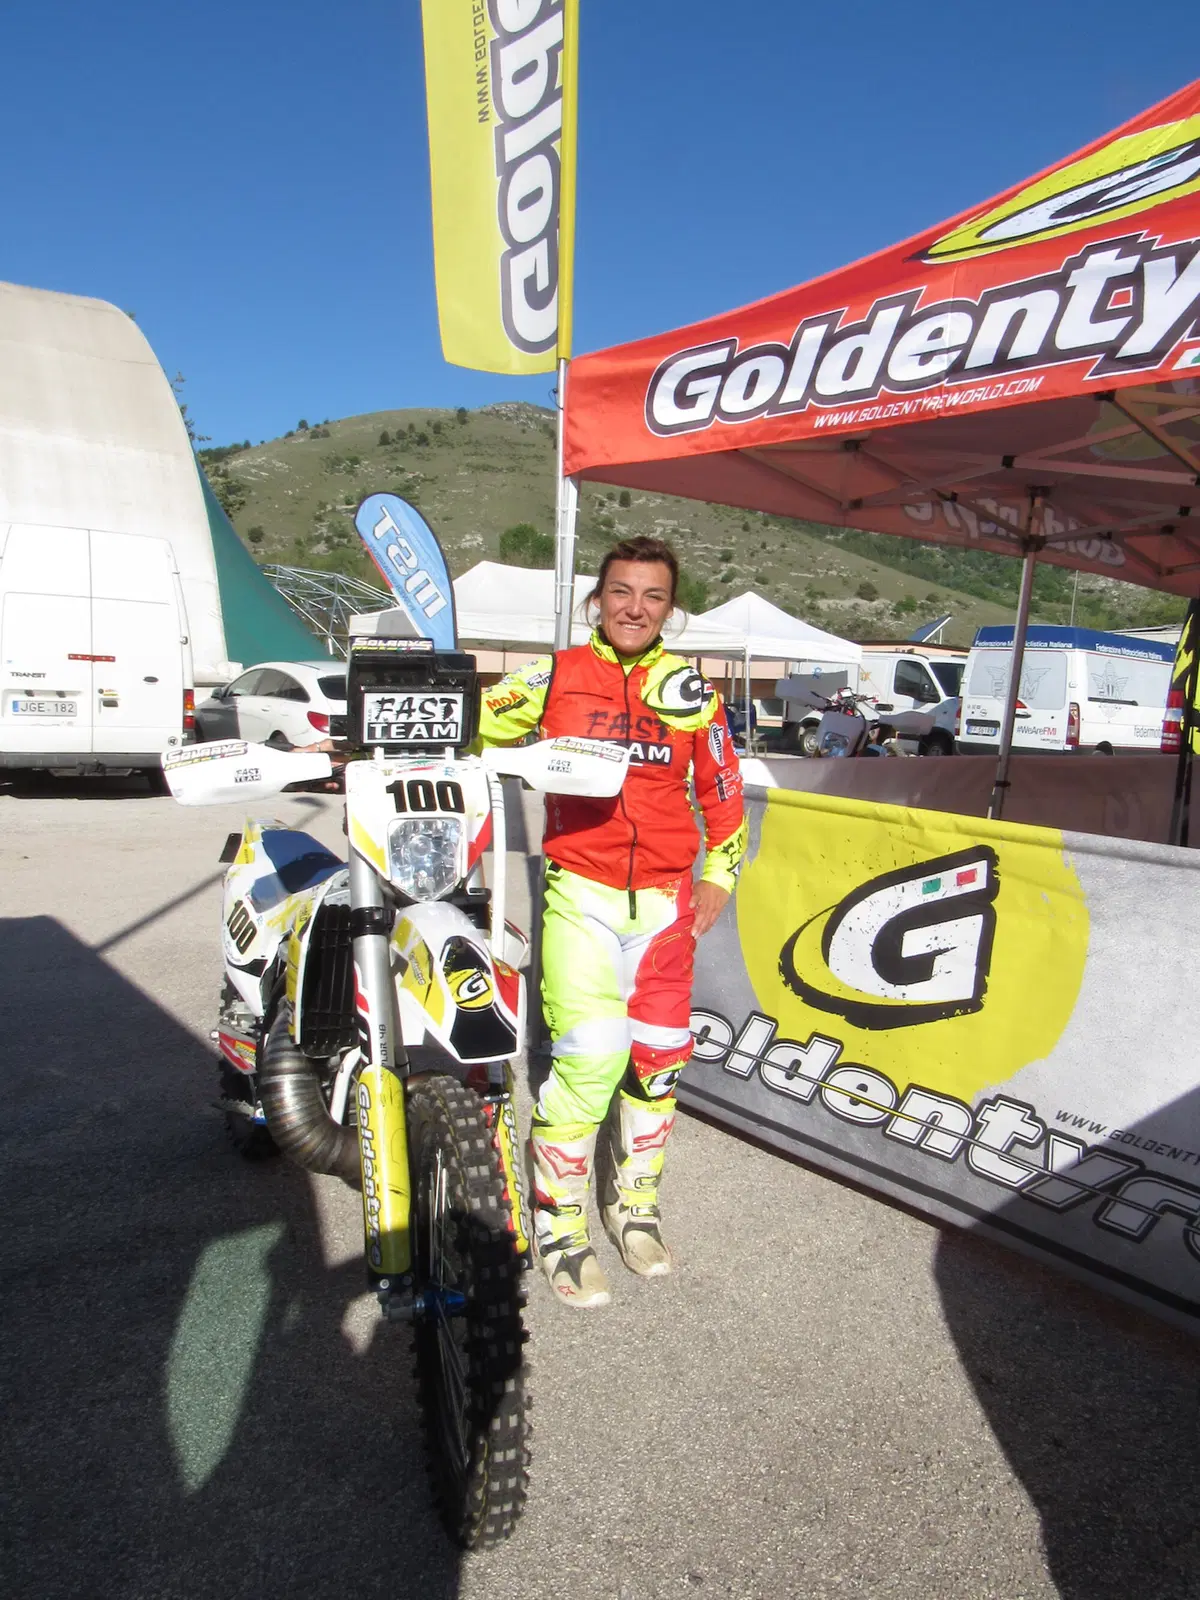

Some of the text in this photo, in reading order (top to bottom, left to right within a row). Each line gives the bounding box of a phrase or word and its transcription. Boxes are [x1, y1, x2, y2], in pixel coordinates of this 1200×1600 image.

[10, 671, 46, 679] TRANSIT
[21, 703, 74, 713] JGE 182
[371, 697, 458, 720] FAST
[370, 723, 457, 739] TEAM
[386, 779, 465, 813] 100
[227, 900, 258, 955] 100
[686, 1008, 1200, 1264] oldentyr
